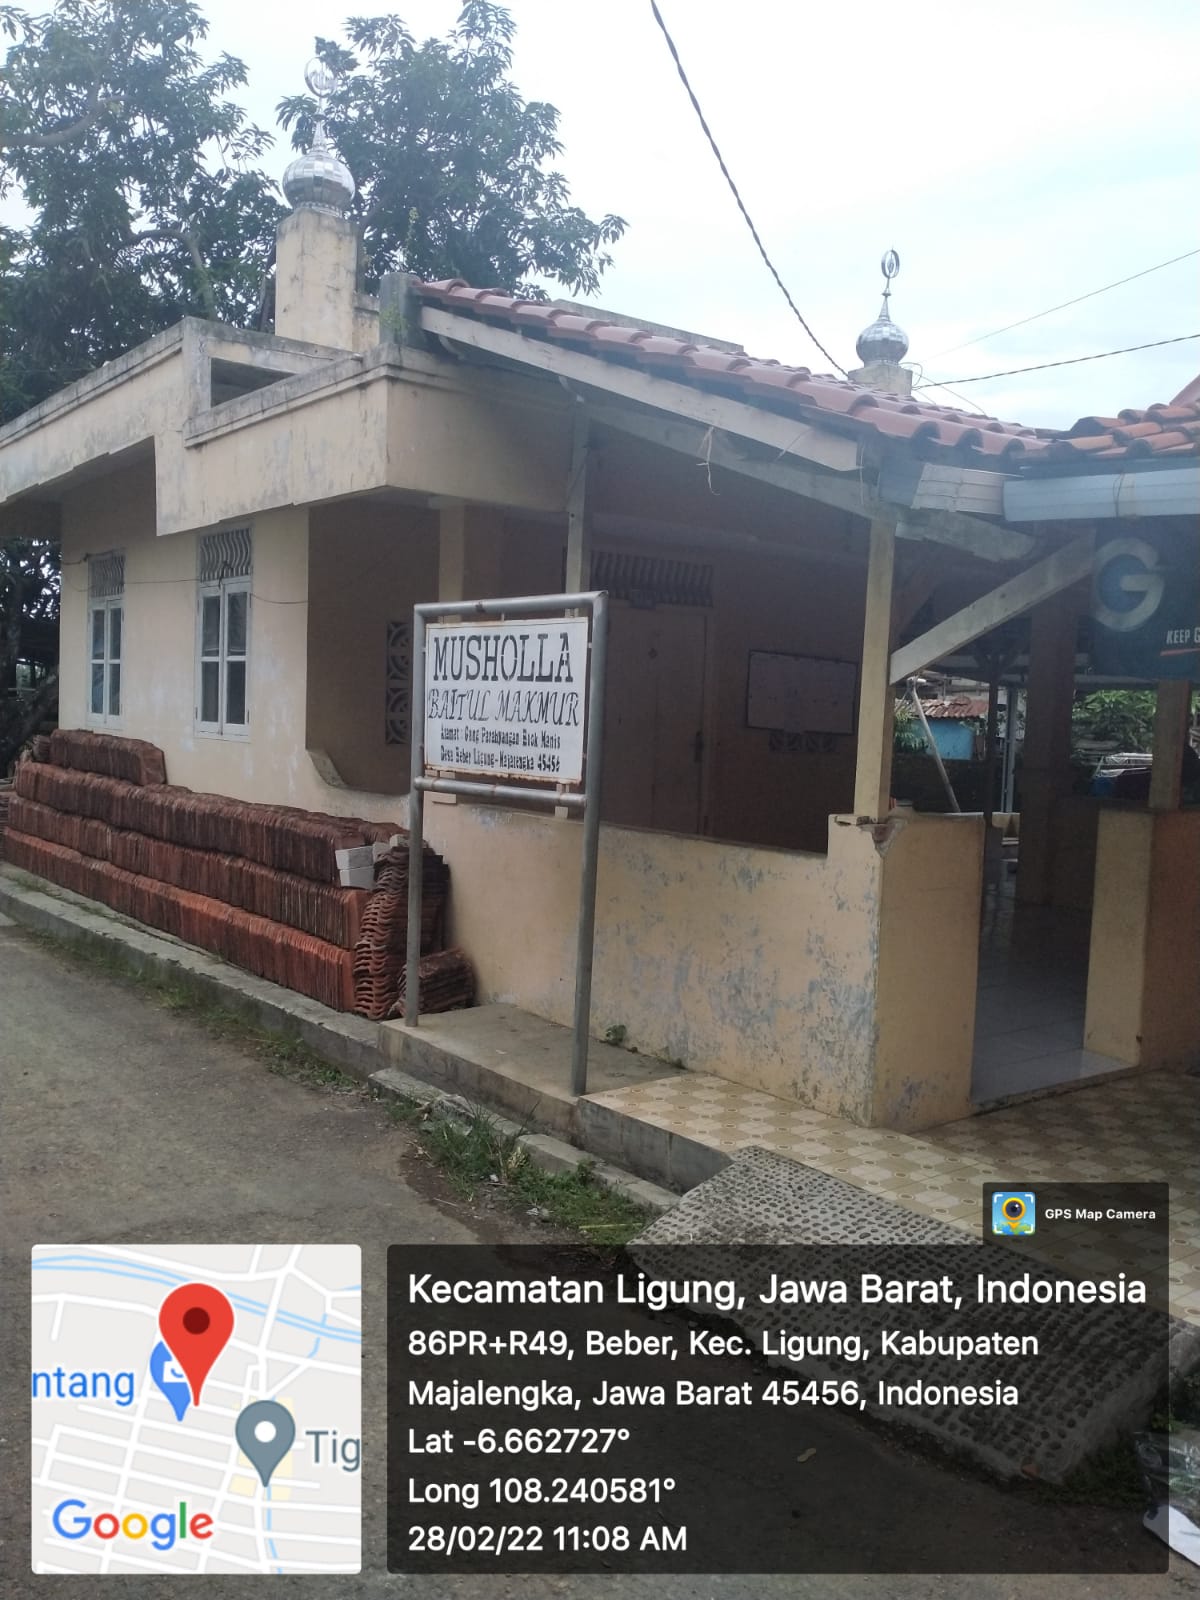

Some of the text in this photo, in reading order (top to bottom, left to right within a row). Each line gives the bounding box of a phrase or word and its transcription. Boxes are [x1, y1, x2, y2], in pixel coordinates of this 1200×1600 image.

[1166, 628, 1191, 645] KEEP
[433, 631, 574, 683] MUSHOLLA
[428, 688, 580, 727] BAITUL MAKMUR
[465, 725, 479, 744] Gang
[522, 728, 538, 748] Blok
[541, 730, 561, 749] Manis
[441, 745, 453, 762] Desa
[456, 745, 471, 764] Beber
